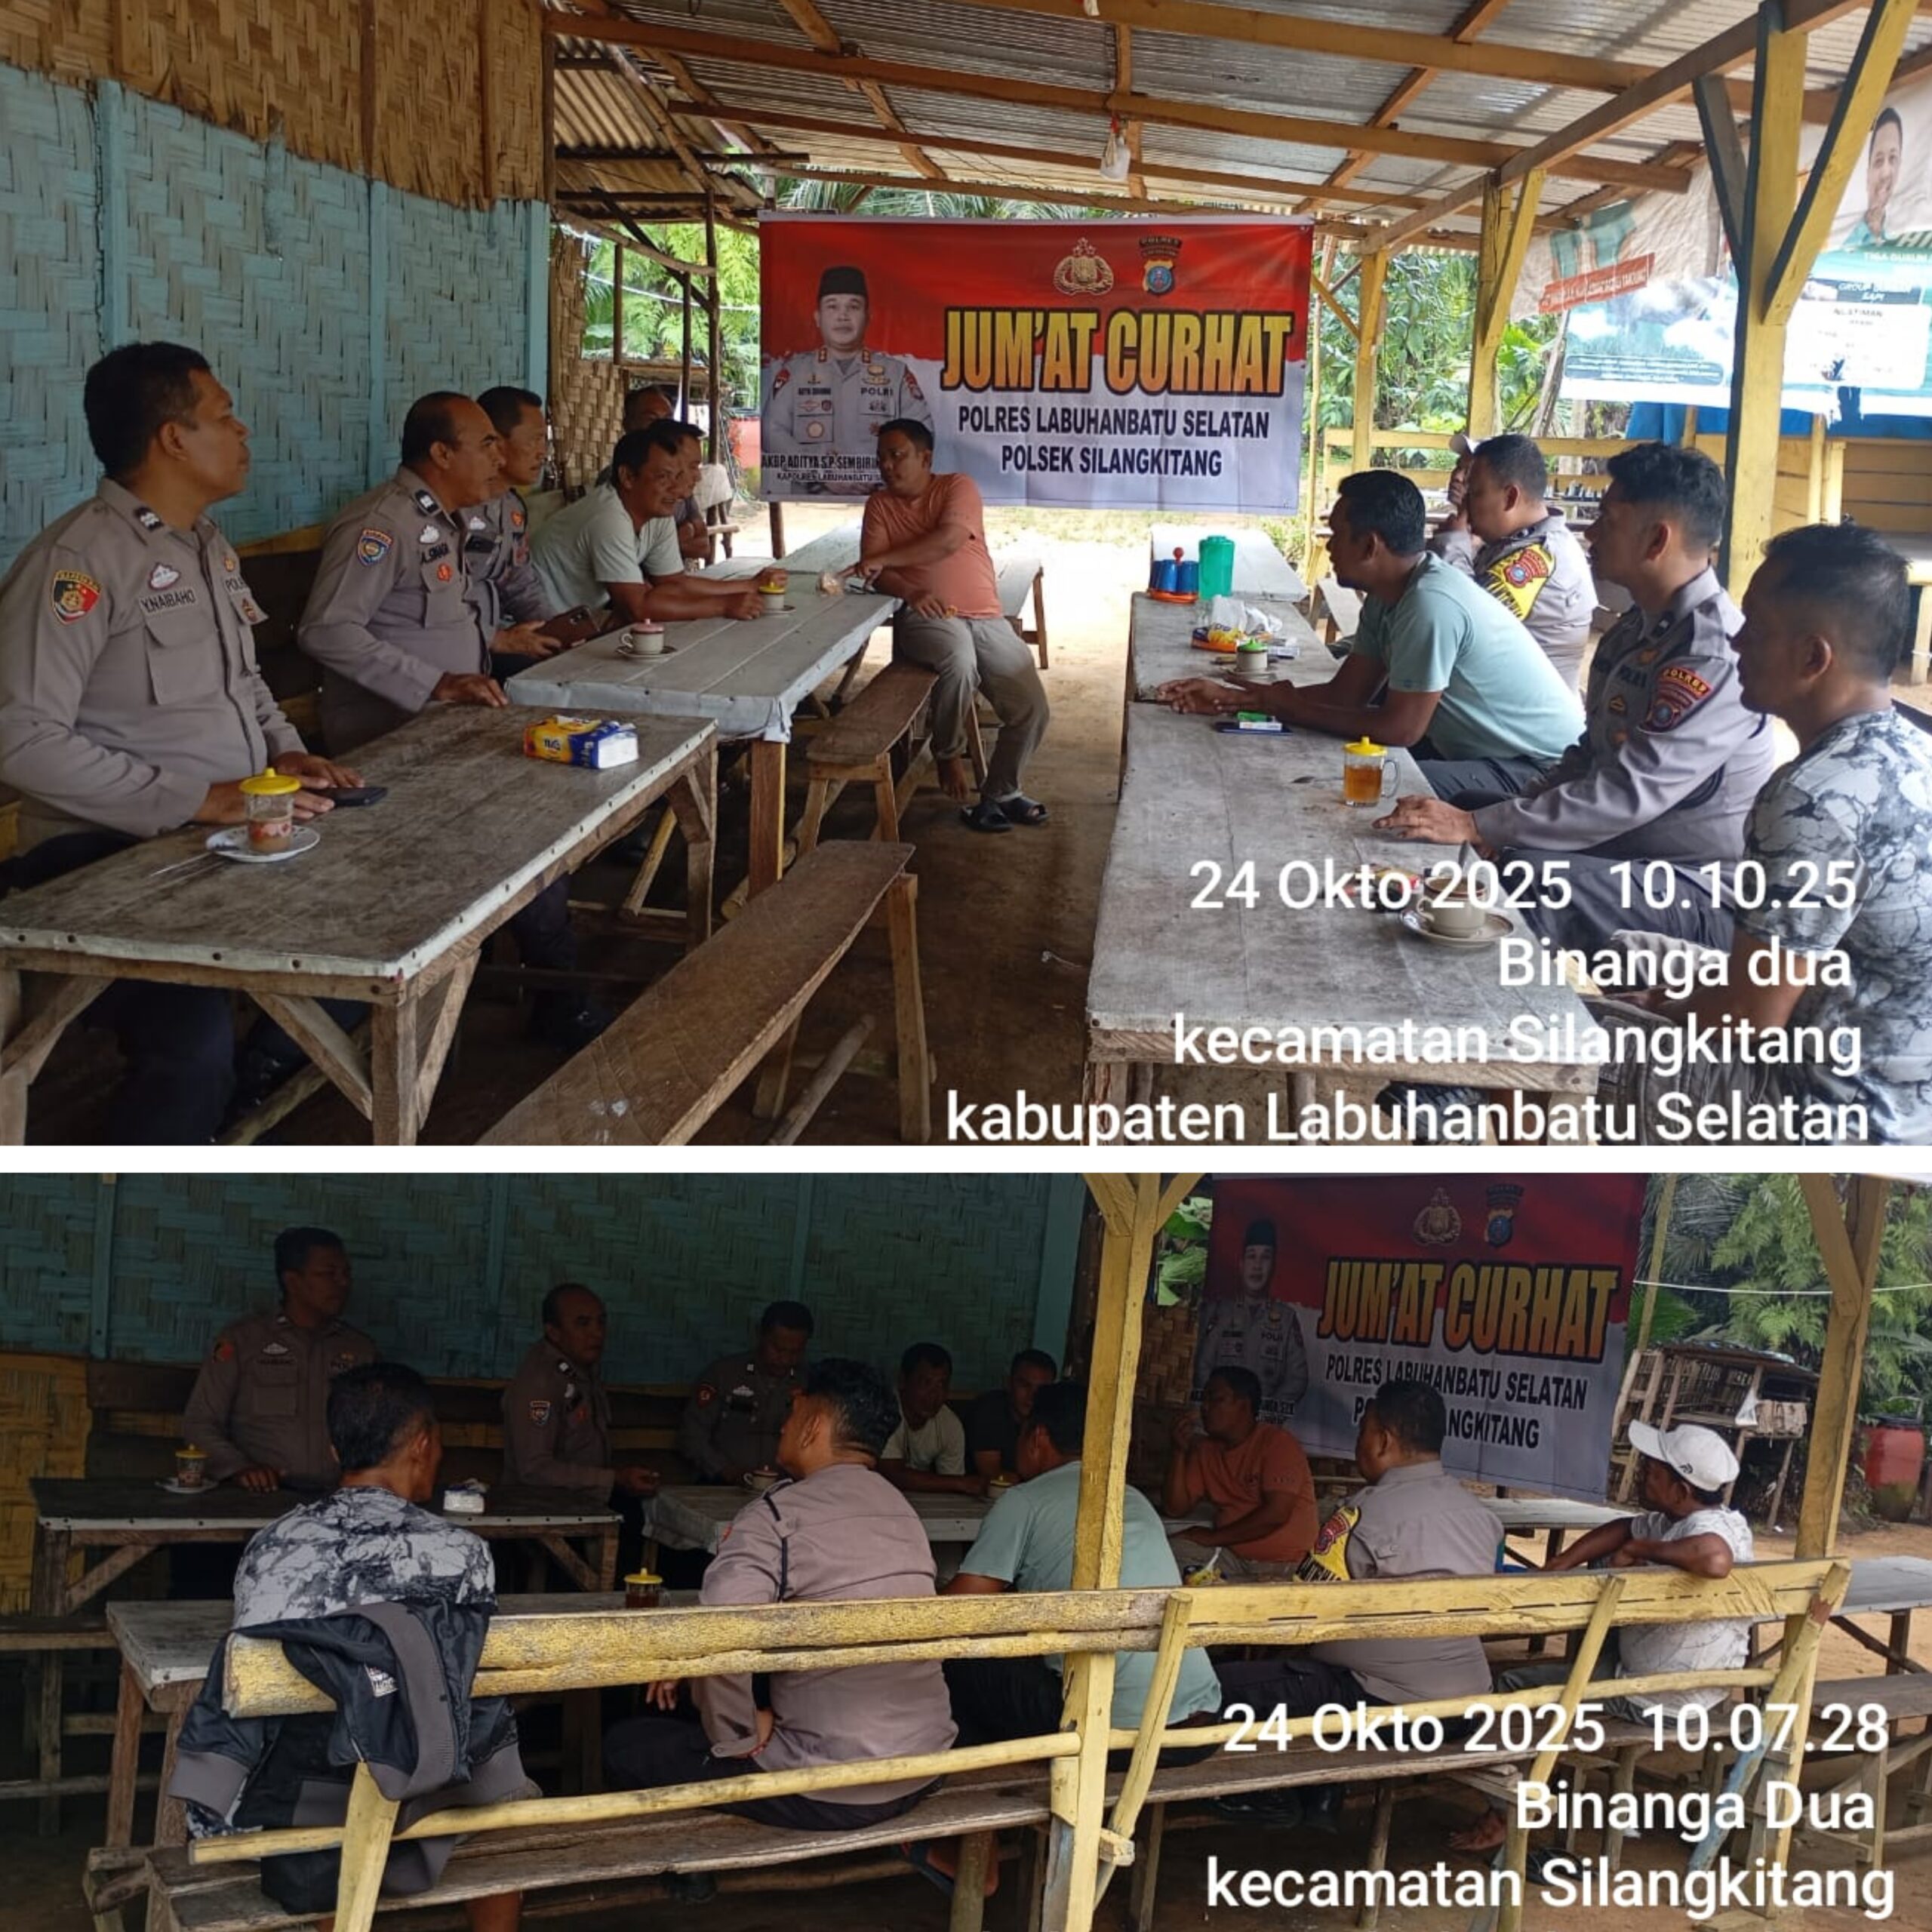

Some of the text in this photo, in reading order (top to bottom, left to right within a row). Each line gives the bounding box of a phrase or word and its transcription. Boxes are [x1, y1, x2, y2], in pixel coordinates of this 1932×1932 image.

[941, 307, 1294, 396] JUM'AT CURHAT
[860, 387, 894, 396] POLRI
[958, 406, 1269, 439] POLRES LABUHANBATU SELATAN
[1001, 445, 1222, 477] POLSEK SILANGKITANG
[1317, 1257, 1621, 1364] JUM'AT CURHAT
[1326, 1355, 1382, 1386] POLRES
[1505, 1371, 1588, 1411] SELATAN
[1447, 1409, 1540, 1449] NGKITANG
